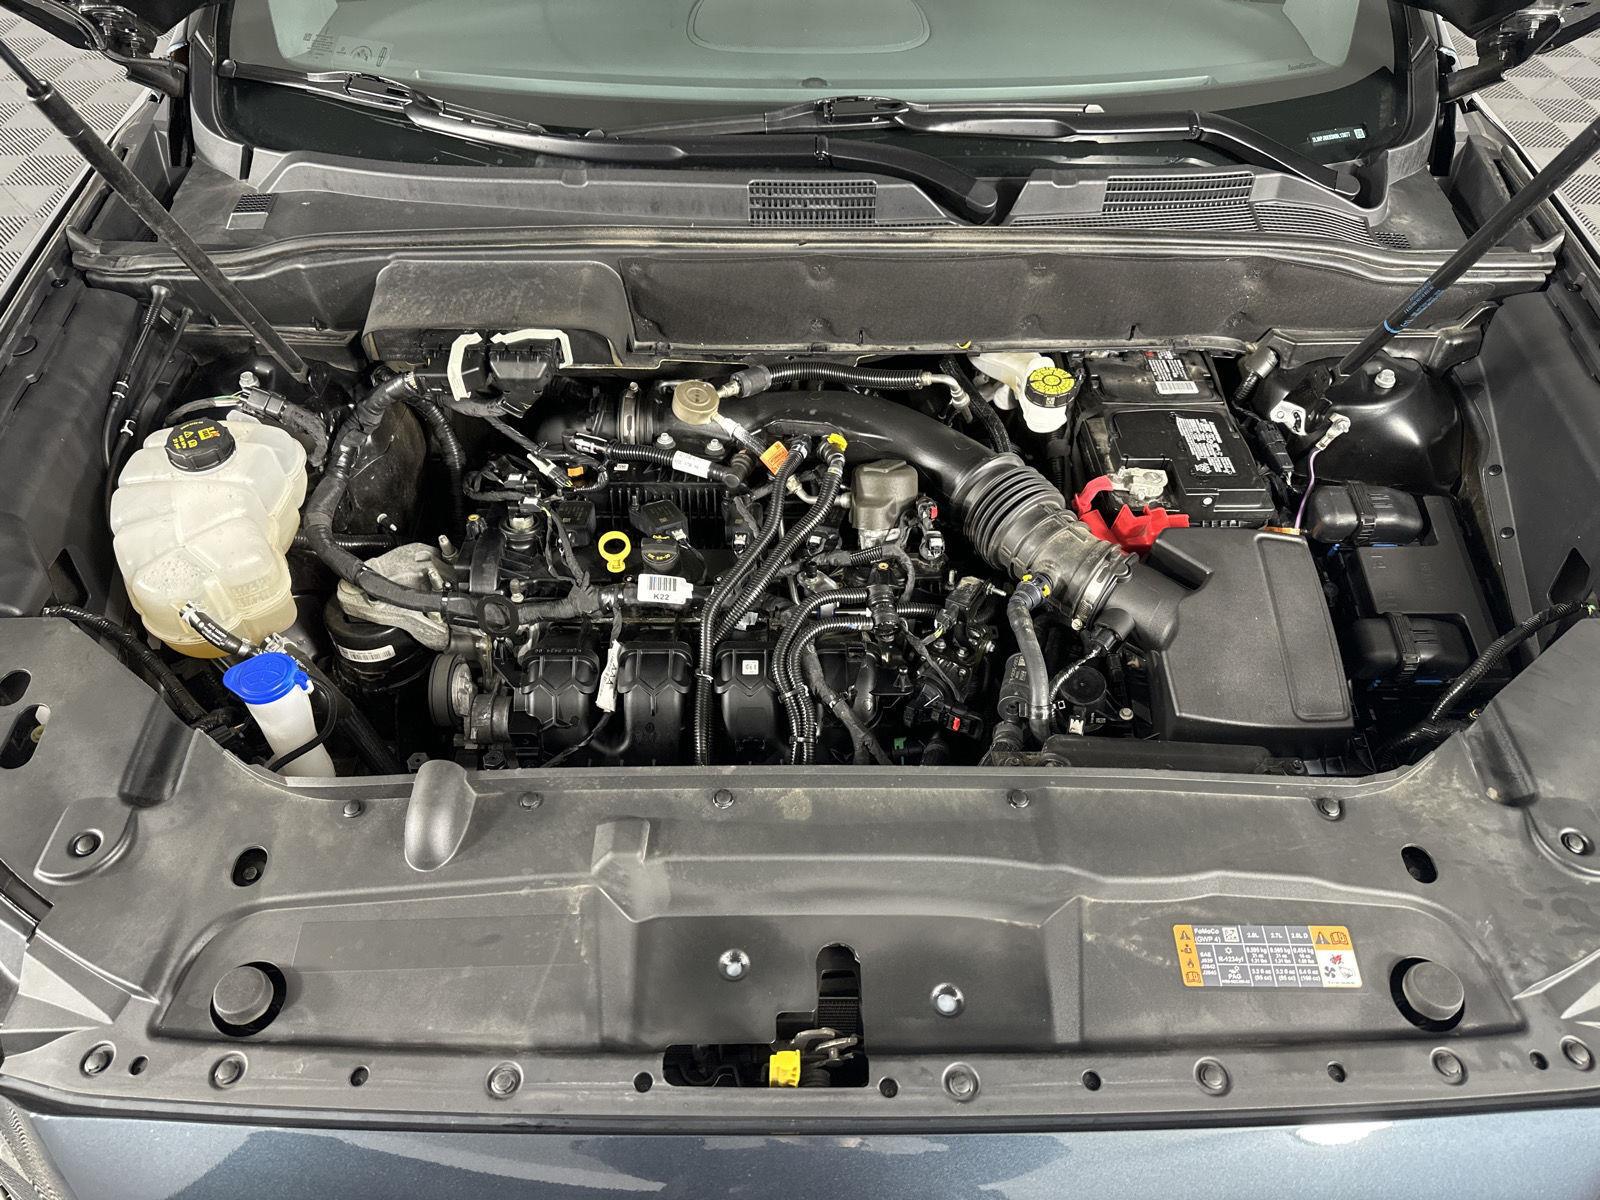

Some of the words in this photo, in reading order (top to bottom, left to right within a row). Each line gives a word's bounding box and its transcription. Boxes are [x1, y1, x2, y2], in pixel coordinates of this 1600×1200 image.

[1194, 927, 1220, 935] FoMoCo
[1195, 935, 1213, 943] (GWP
[1214, 935, 1221, 943] 4)
[1260, 946, 1268, 954] kg
[1284, 946, 1291, 954] kg
[1307, 946, 1314, 954] kg
[1218, 956, 1244, 964] R-1234yf
